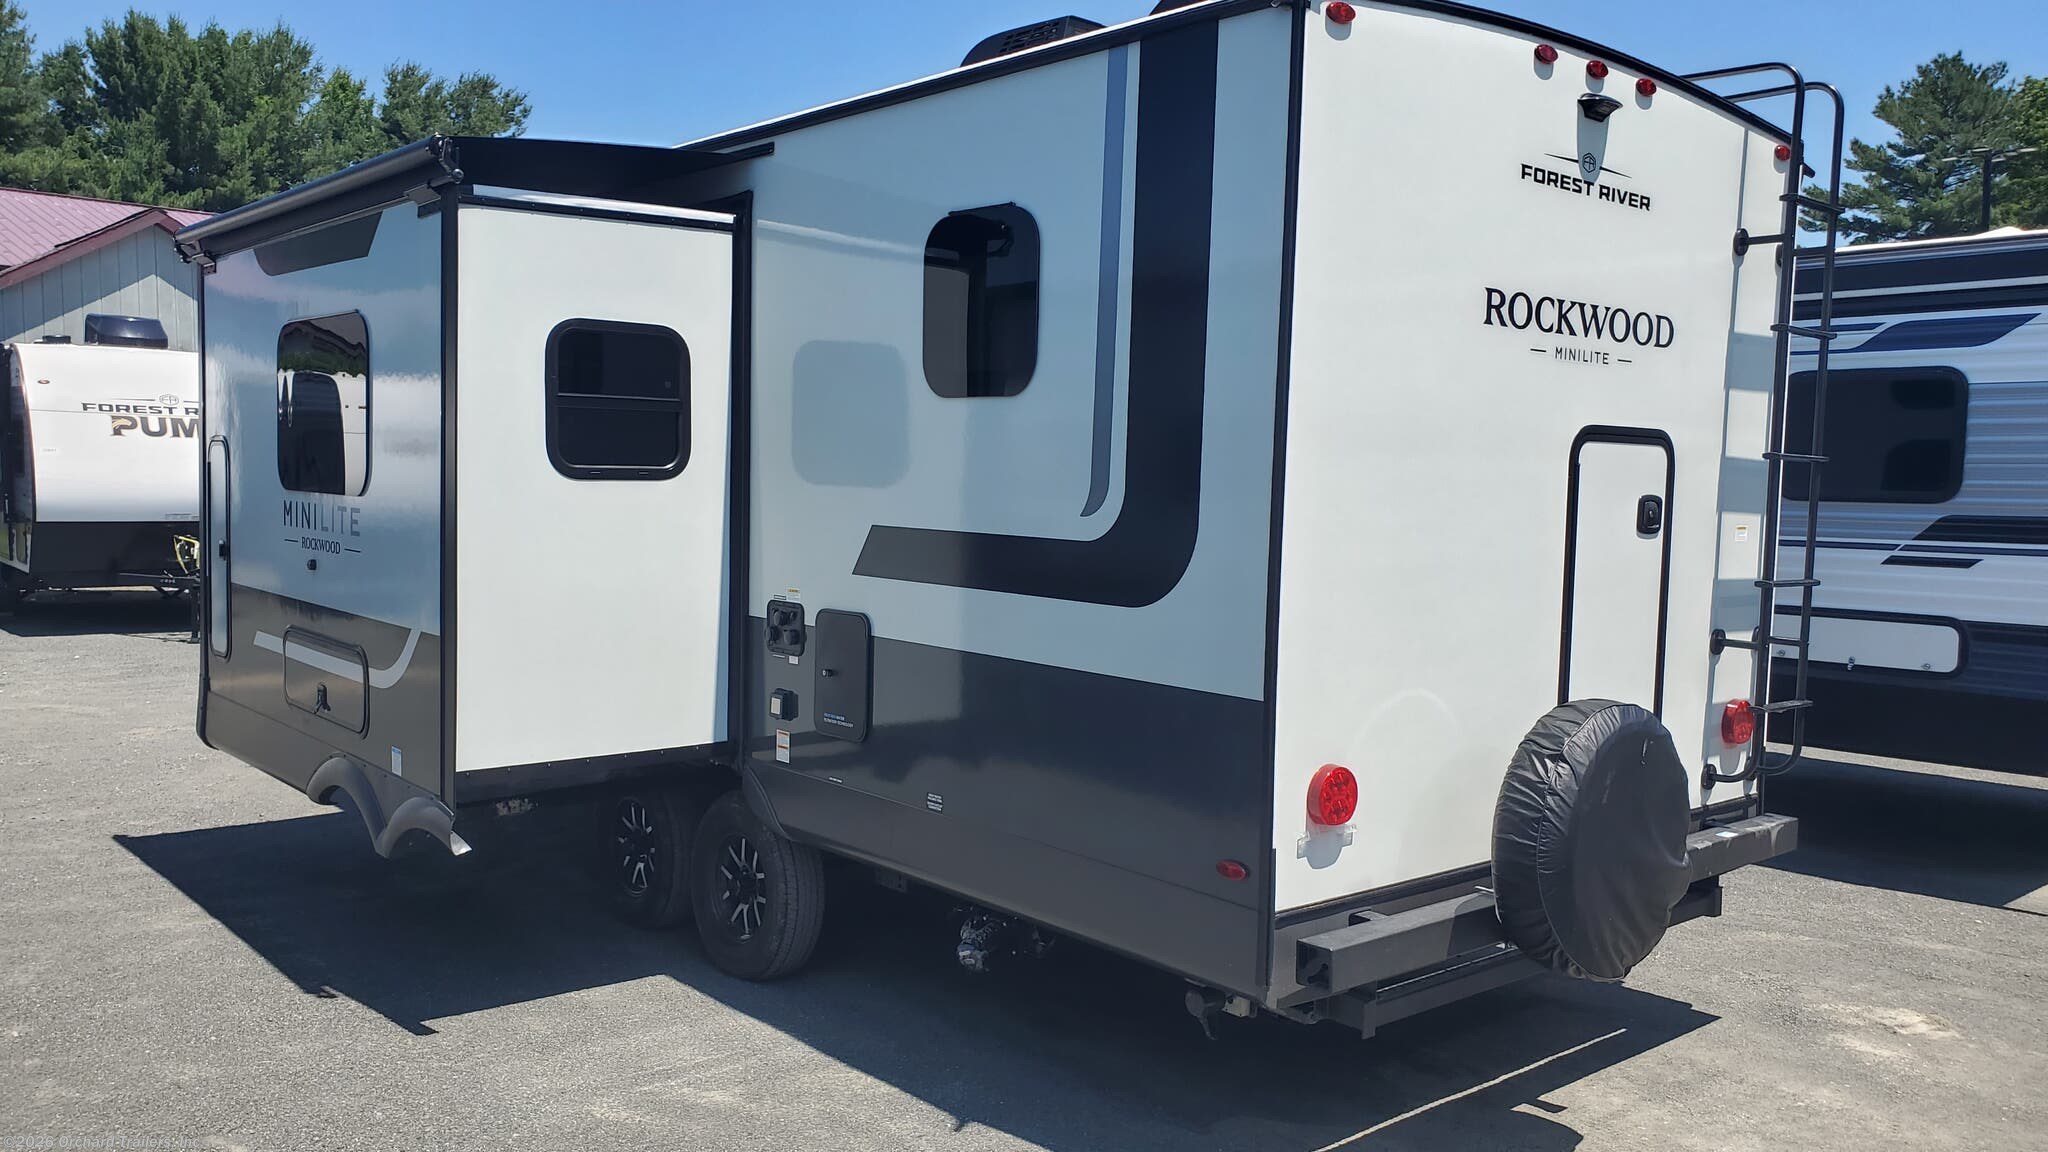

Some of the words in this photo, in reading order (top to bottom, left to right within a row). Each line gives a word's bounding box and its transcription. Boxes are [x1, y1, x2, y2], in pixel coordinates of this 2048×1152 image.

[1520, 163, 1594, 197] FOREST
[1599, 184, 1651, 211] RIVER
[1483, 287, 1675, 348] ROCKWOOD
[1555, 347, 1610, 365] MINILITE
[81, 403, 177, 415] FOREST
[301, 537, 341, 554] ROCKWOOD
